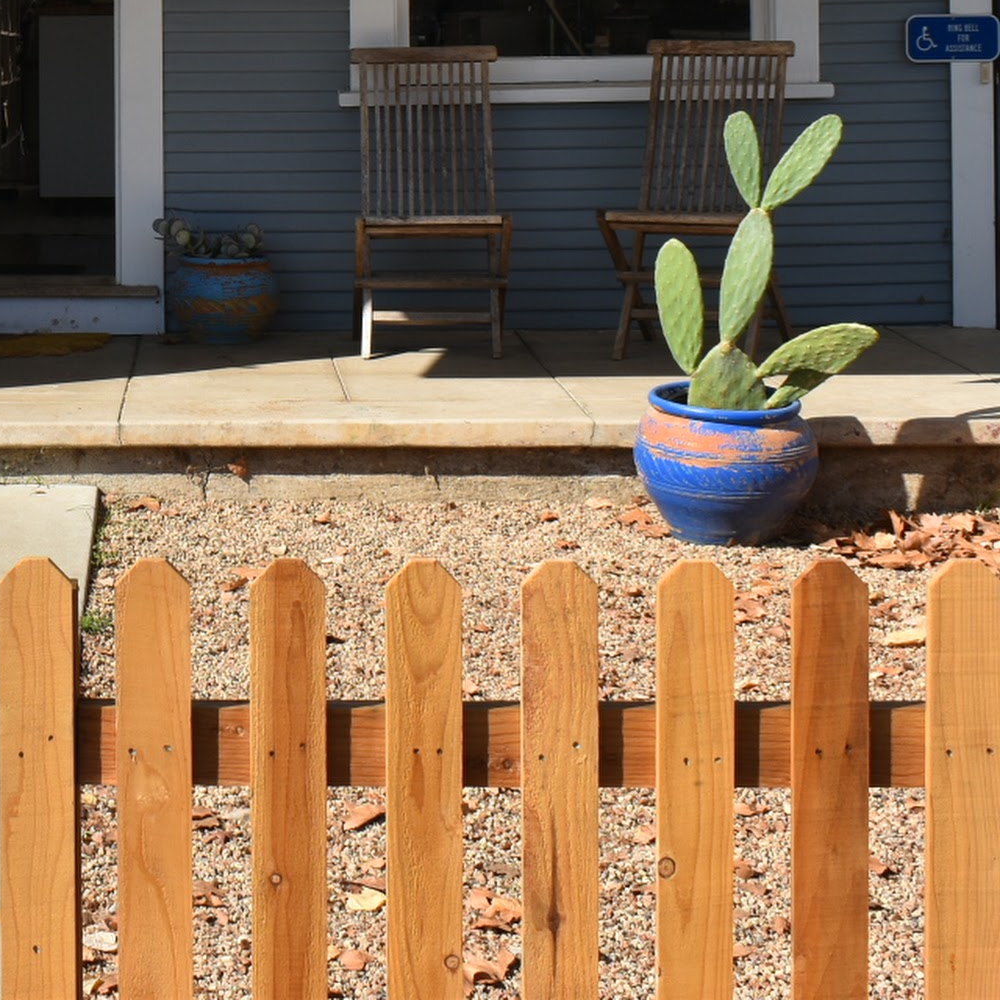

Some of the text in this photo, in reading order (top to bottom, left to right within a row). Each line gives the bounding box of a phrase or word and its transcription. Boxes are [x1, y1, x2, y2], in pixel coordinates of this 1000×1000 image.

[964, 23, 979, 32] BELL
[957, 34, 970, 42] FOR
[945, 43, 983, 52] ASSISTANCE
